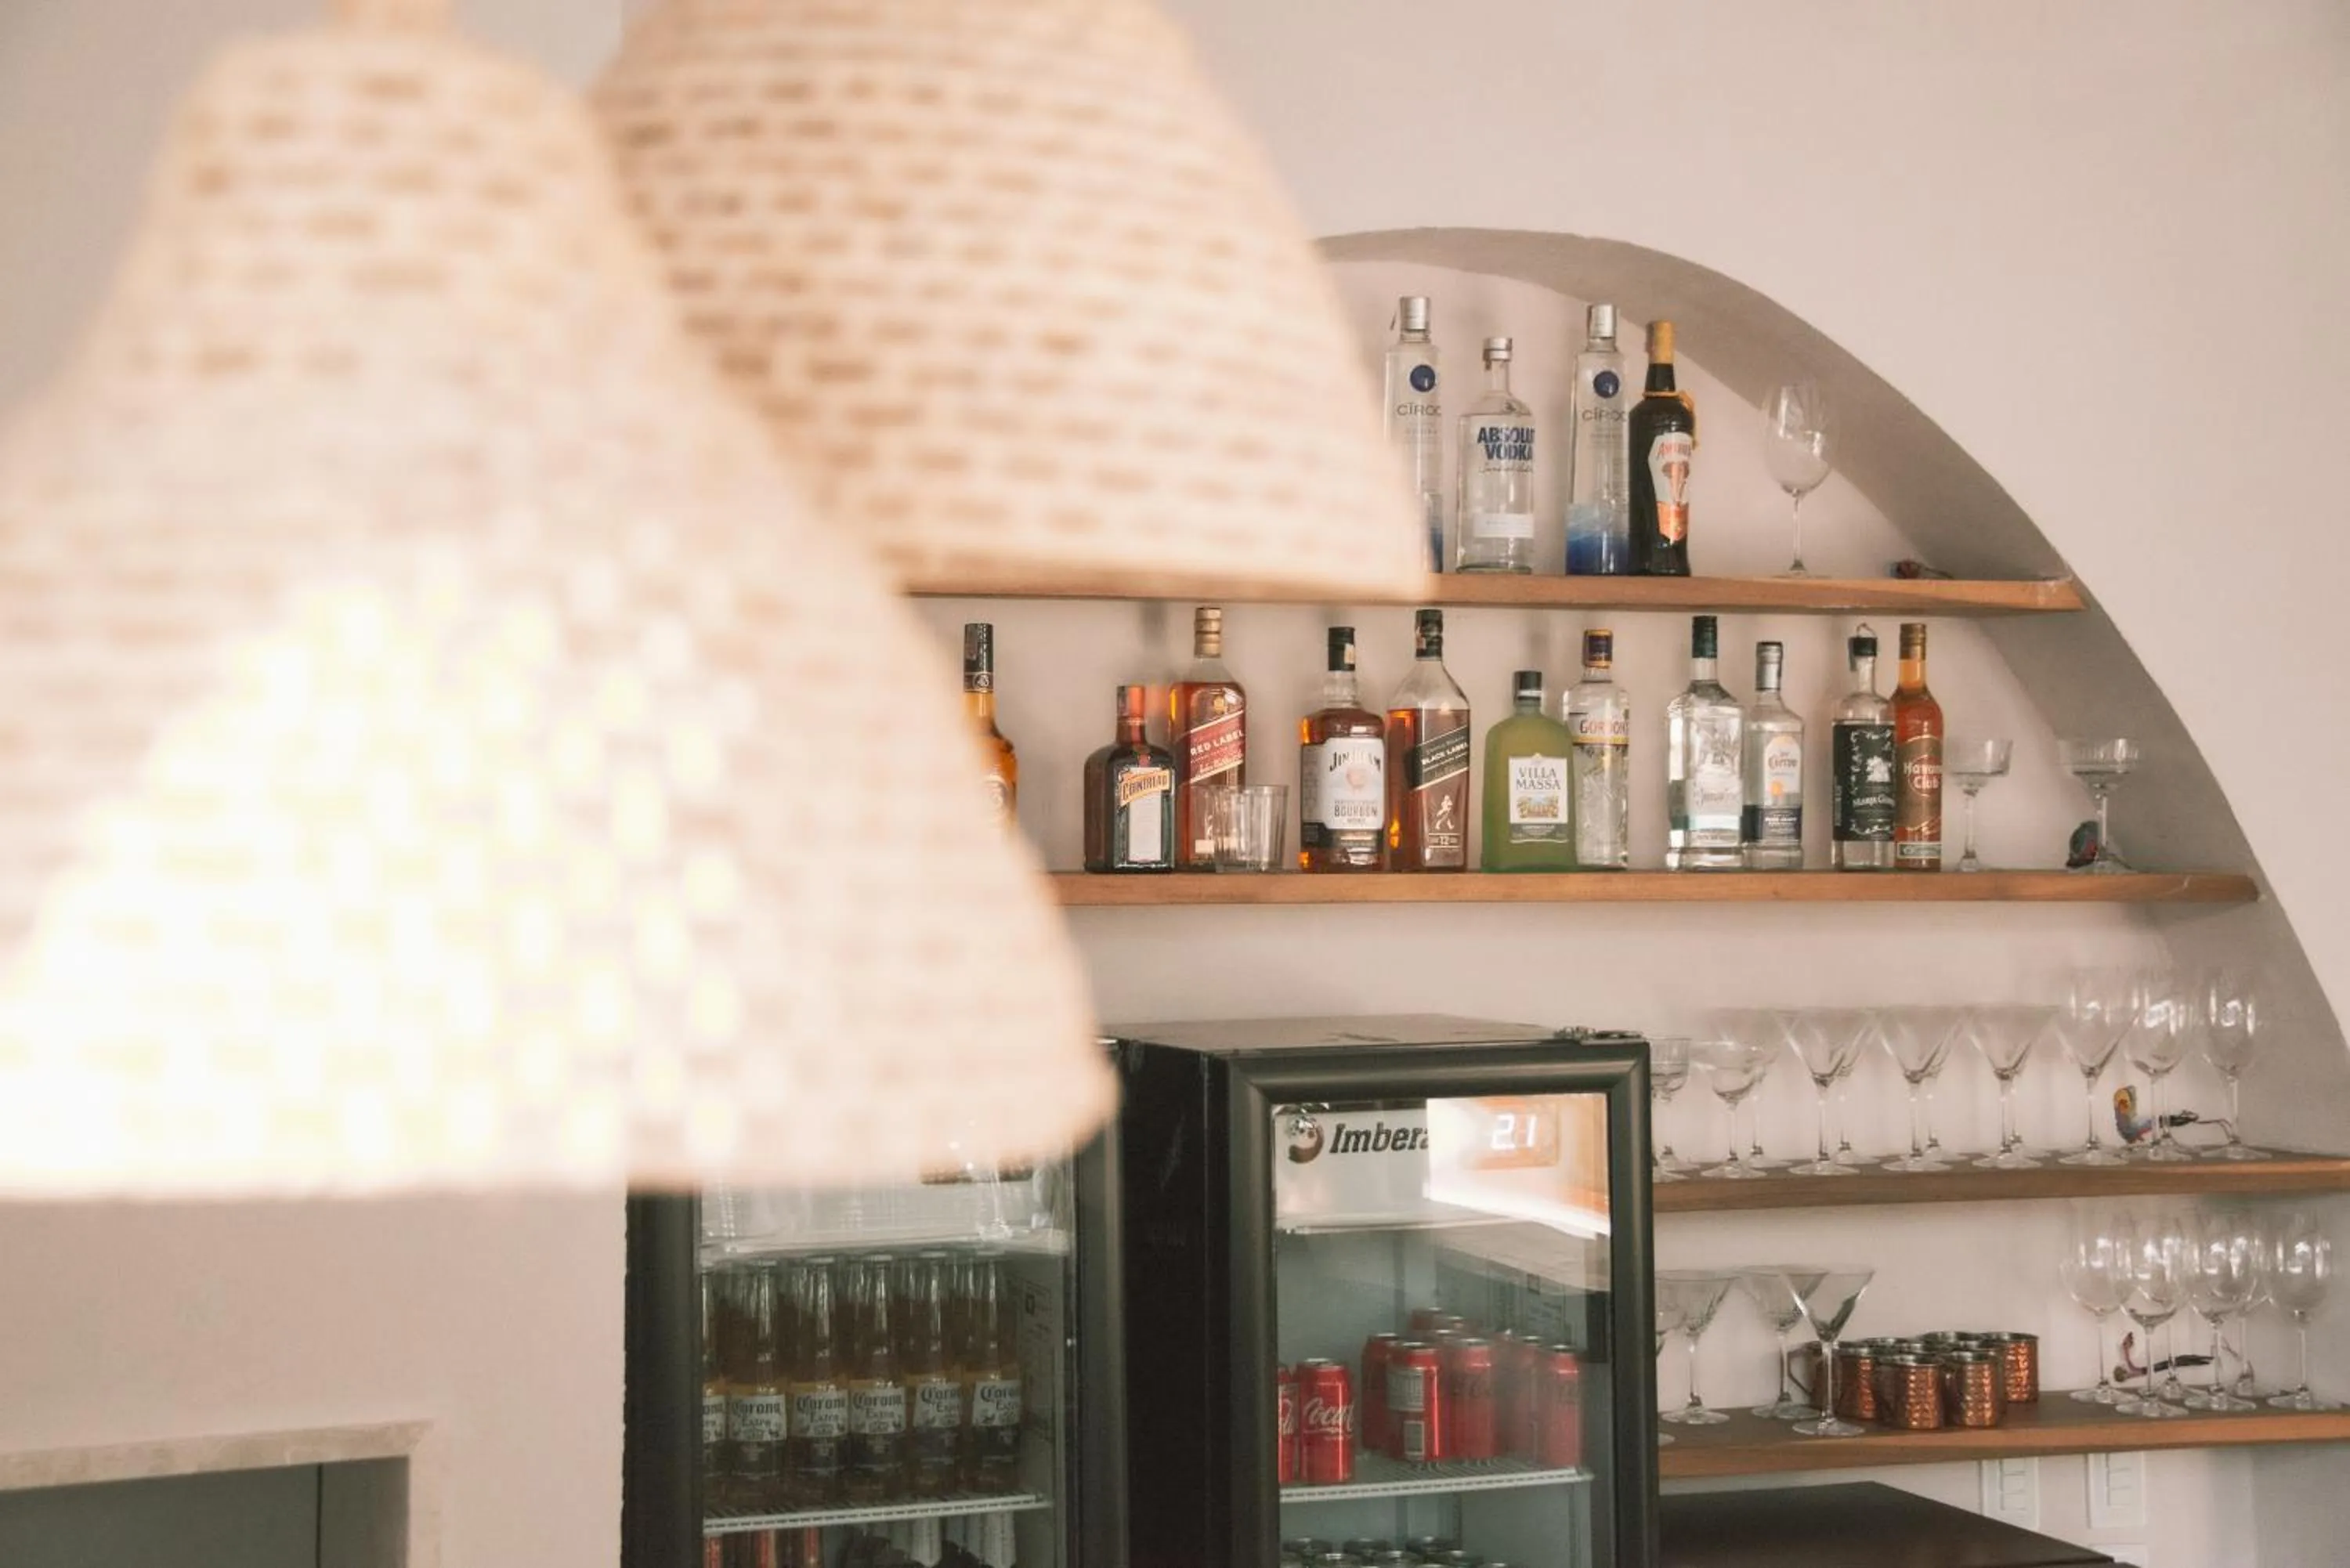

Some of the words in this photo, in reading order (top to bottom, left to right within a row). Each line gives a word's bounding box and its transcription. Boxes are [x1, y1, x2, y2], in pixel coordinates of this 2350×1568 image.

[1190, 741, 1211, 757] RED
[1518, 767, 1557, 779] VILLA
[1516, 778, 1561, 790] MASSA
[1913, 775, 1940, 789] Club
